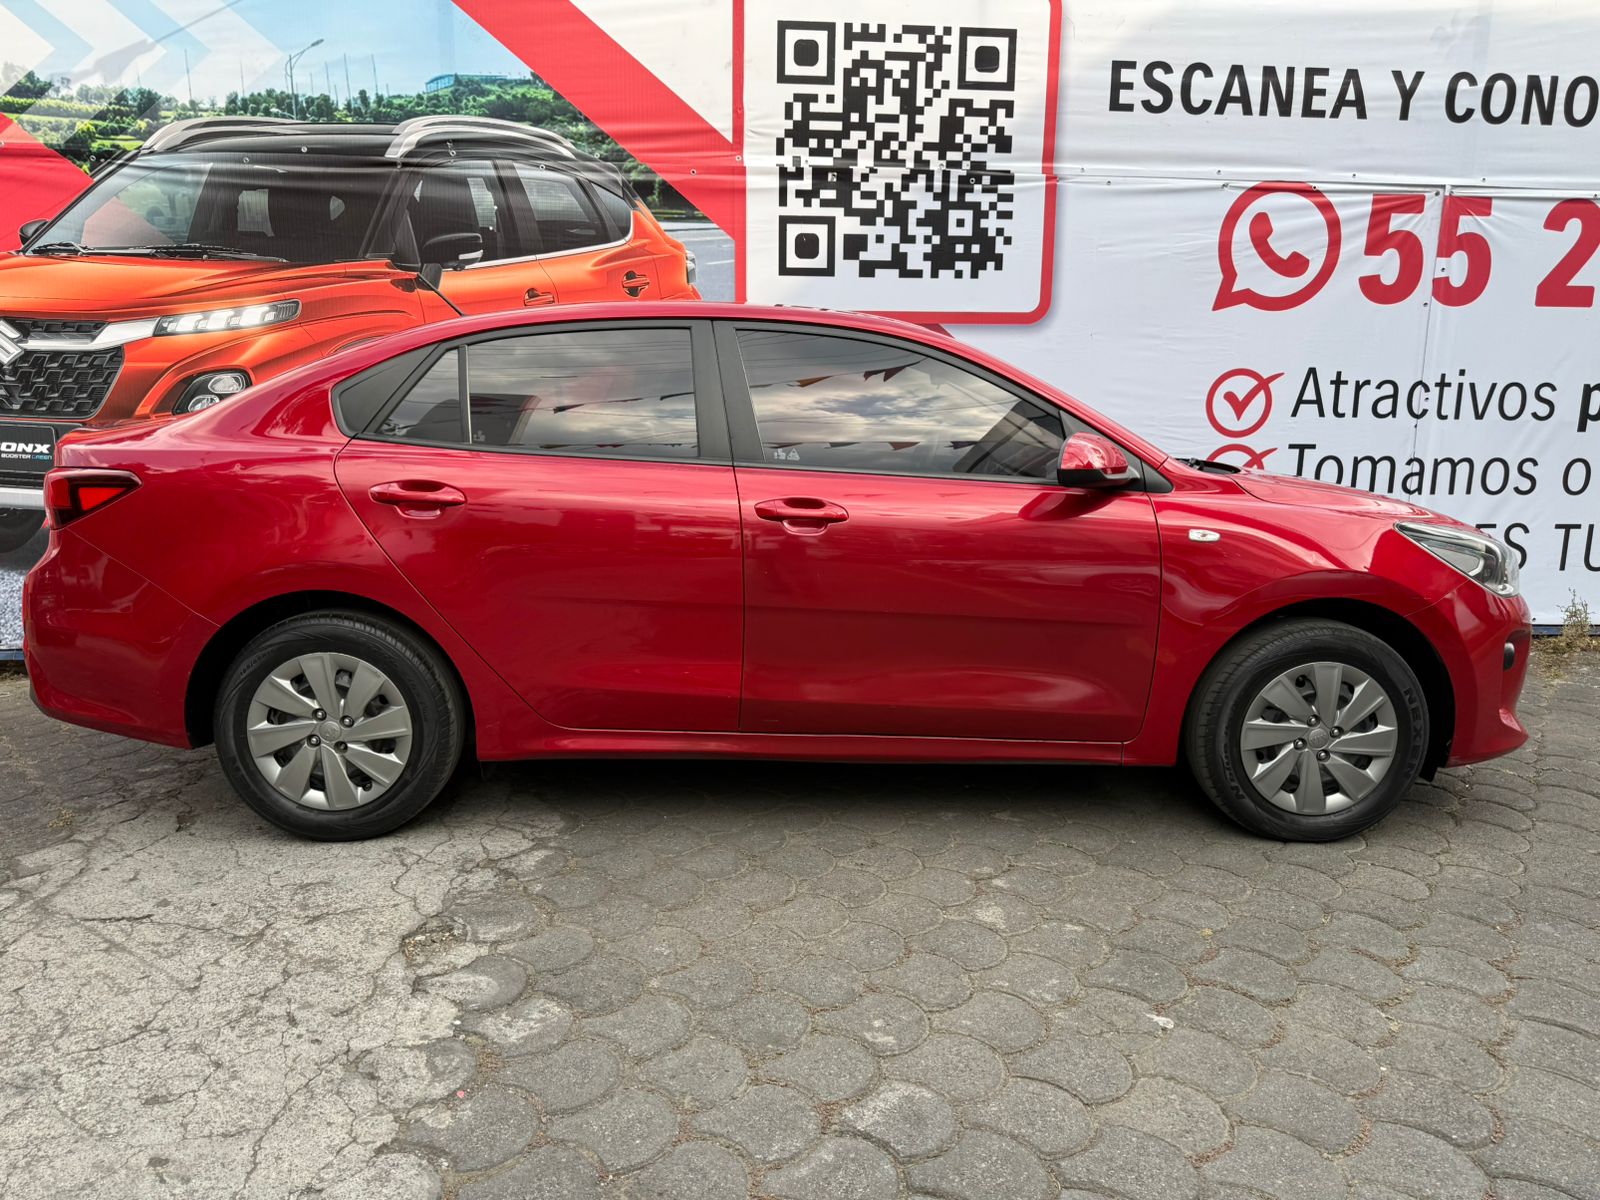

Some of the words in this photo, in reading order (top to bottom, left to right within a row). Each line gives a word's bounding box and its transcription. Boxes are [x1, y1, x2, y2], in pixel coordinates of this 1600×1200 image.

[1108, 60, 1368, 120] ESCANEA
[1392, 71, 1424, 120] Y
[1446, 72, 1600, 127] CONO
[1359, 194, 1492, 307] 55
[1536, 200, 1600, 308] 2
[1291, 367, 1557, 421] Atractivos
[1288, 444, 1538, 495] Tomamos
[1563, 458, 1591, 495] o
